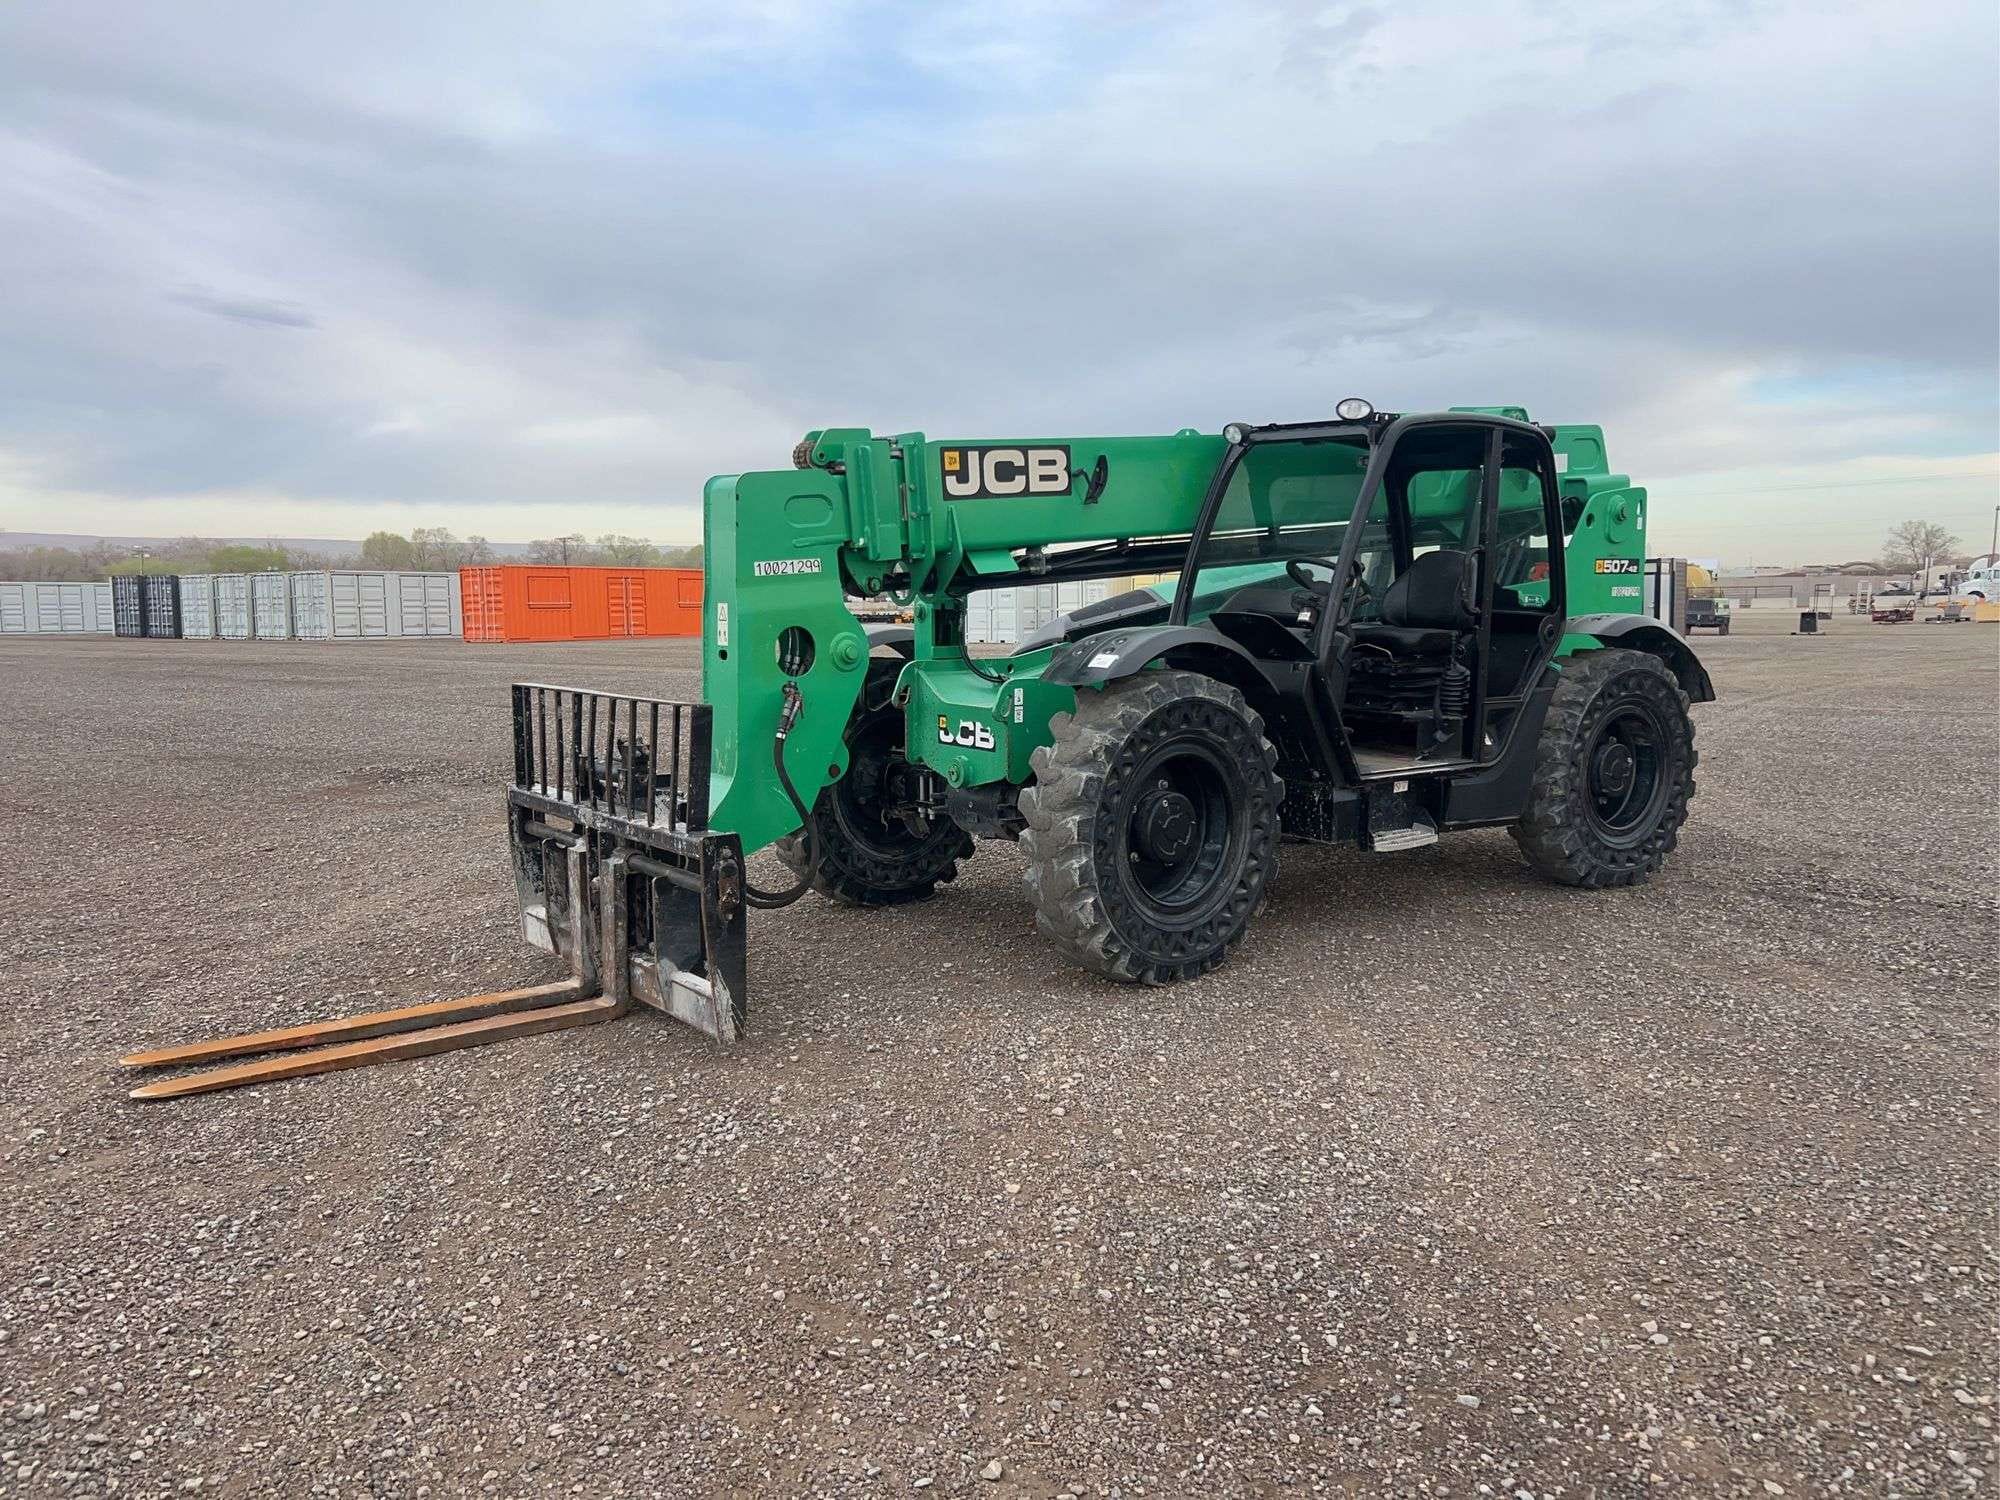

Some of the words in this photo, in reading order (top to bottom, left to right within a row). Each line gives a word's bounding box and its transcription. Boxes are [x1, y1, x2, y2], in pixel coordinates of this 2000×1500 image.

[944, 449, 1069, 496] JCB
[756, 560, 821, 575] 10021299
[939, 719, 995, 749] JCB
